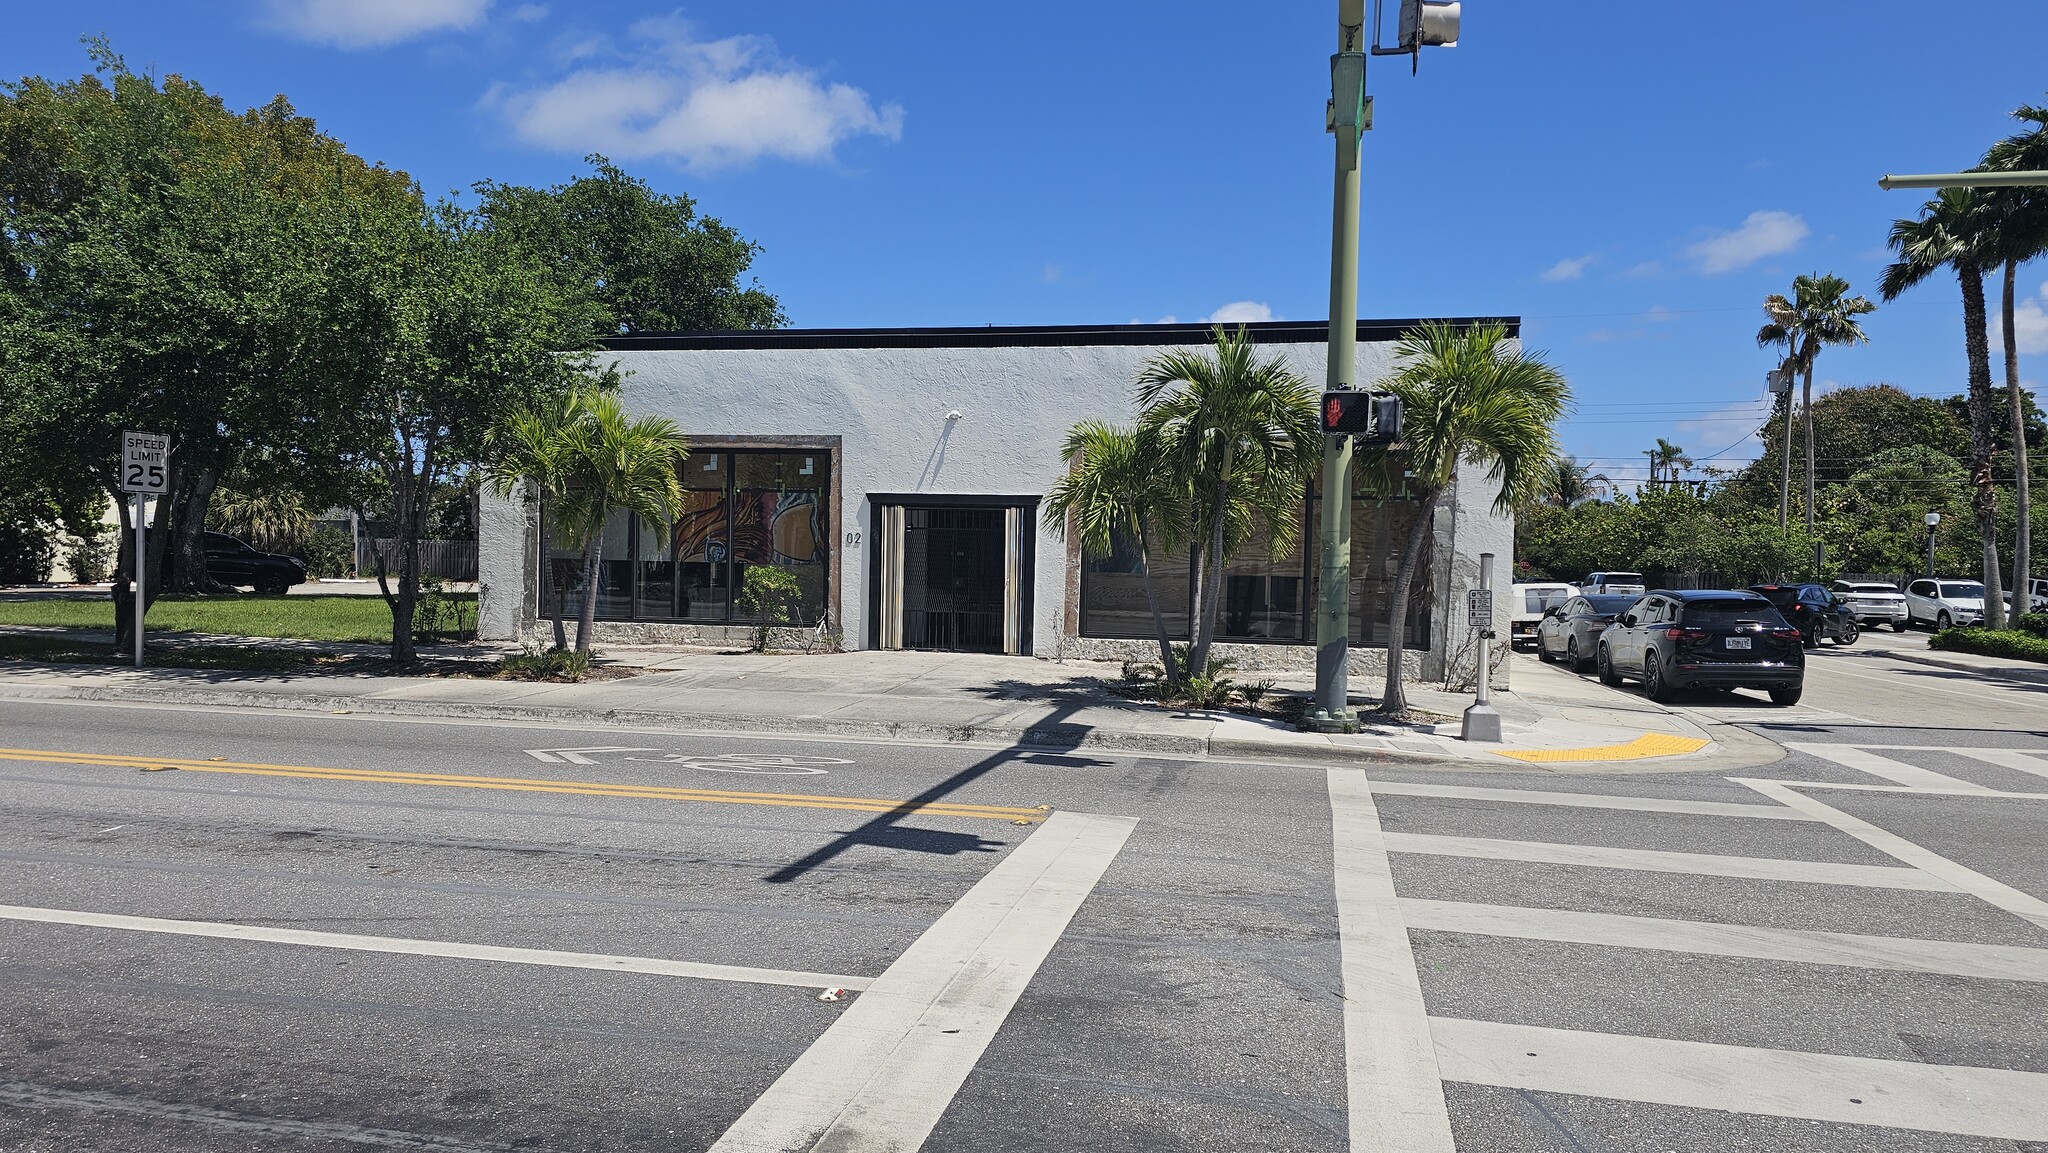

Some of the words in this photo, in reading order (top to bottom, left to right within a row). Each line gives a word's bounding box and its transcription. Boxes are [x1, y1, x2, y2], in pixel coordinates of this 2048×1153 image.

[127, 438, 166, 450] SPEED
[131, 450, 161, 462] LIMIT
[127, 464, 164, 488] 25
[846, 532, 861, 543] 02
